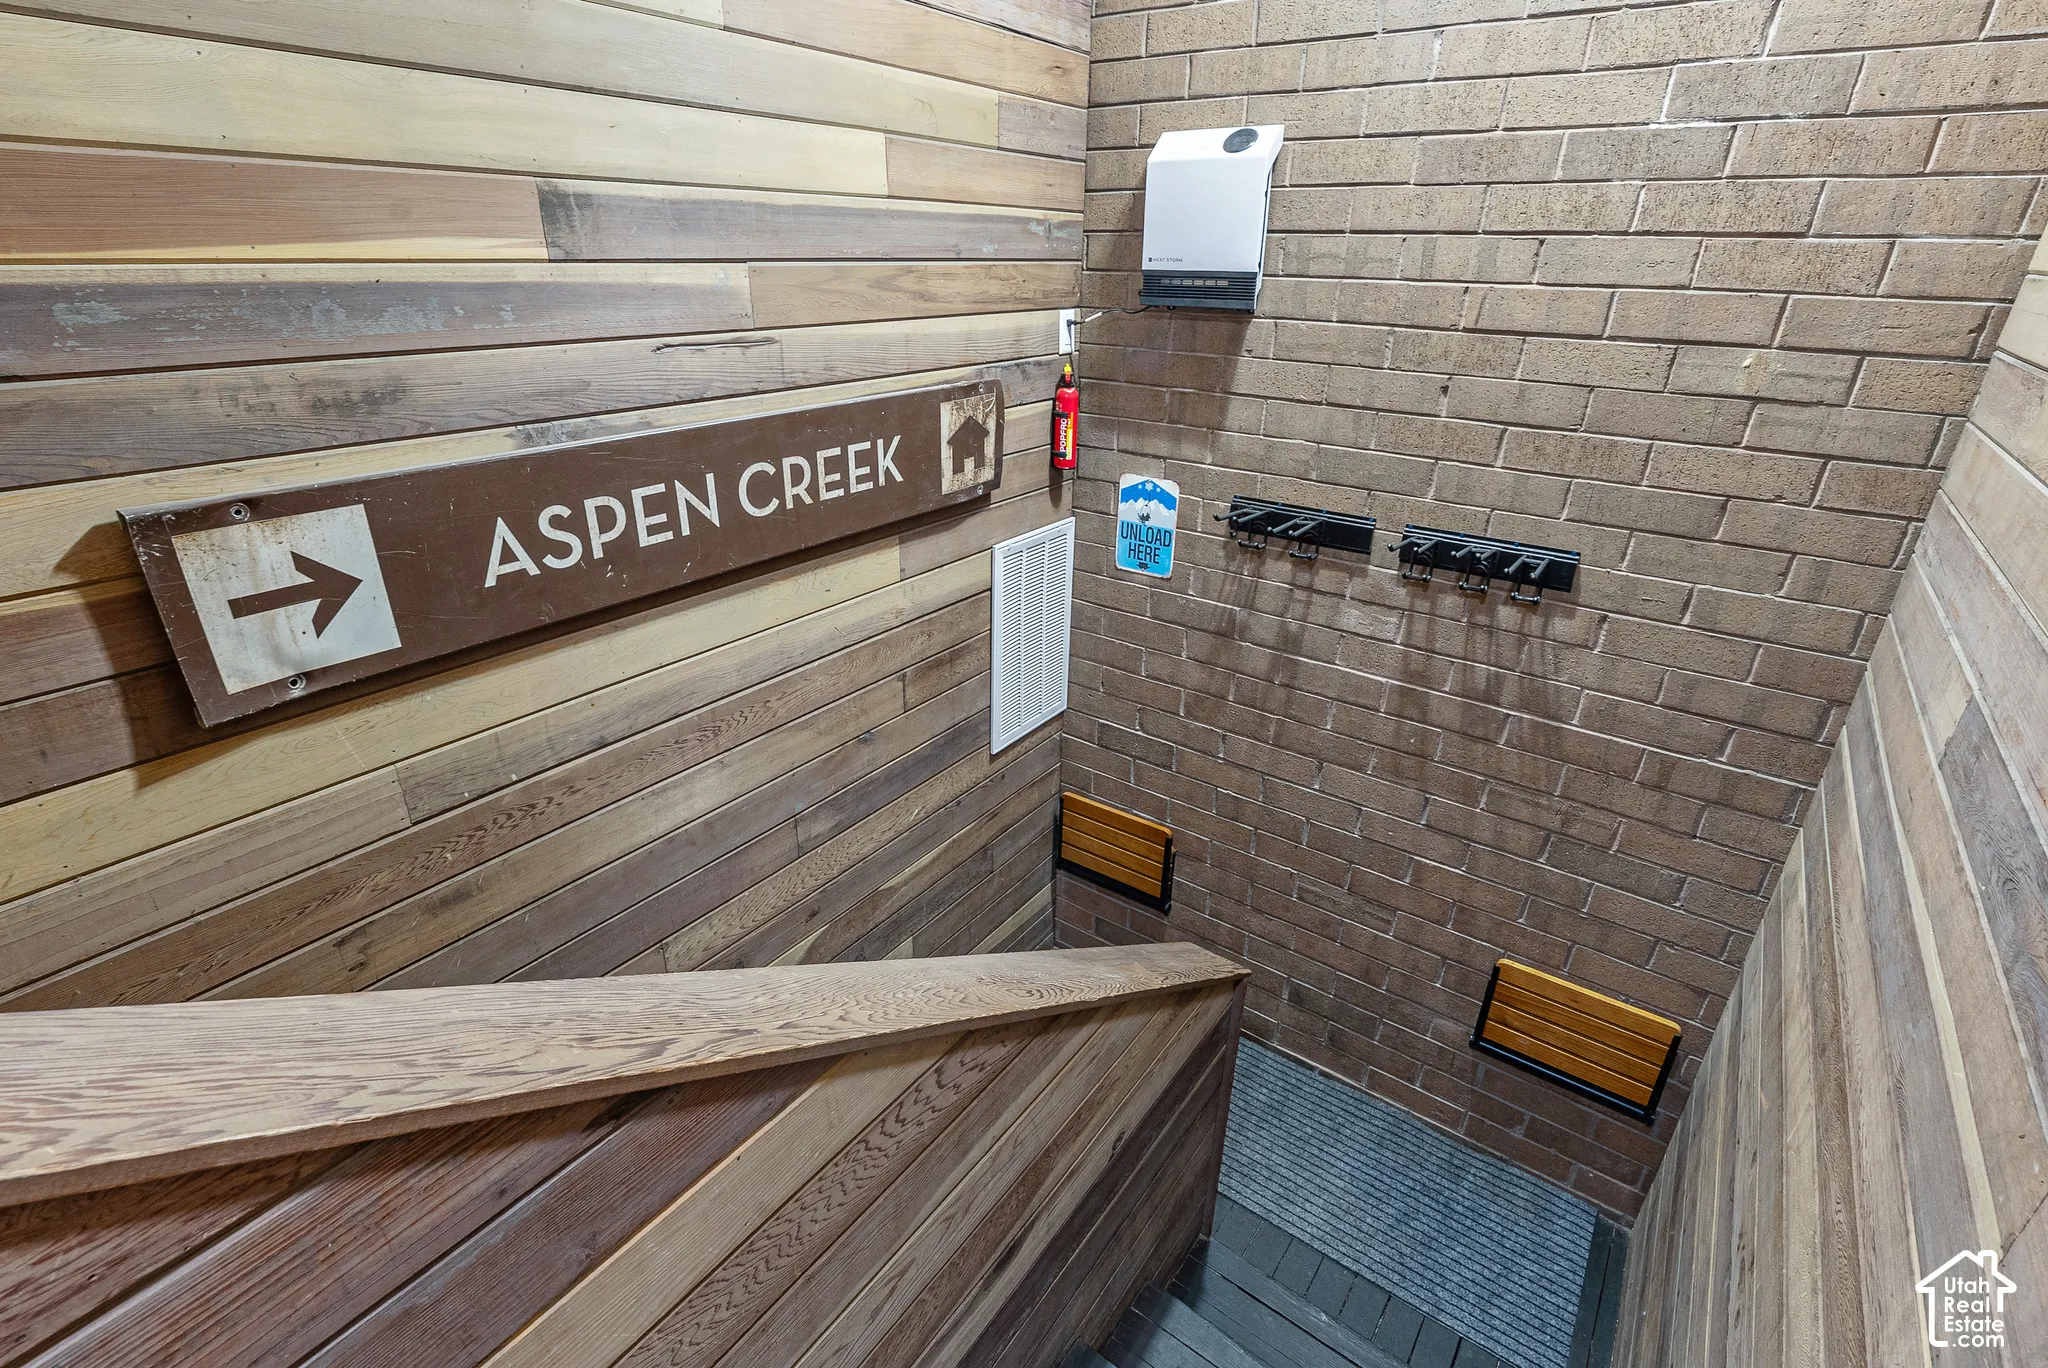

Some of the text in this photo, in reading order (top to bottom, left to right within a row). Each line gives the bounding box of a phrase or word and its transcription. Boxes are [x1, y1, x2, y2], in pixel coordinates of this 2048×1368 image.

[484, 435, 904, 588] ASPEN CREEK
[1120, 521, 1172, 548] UNLOAD
[1128, 541, 1161, 565] HERE
